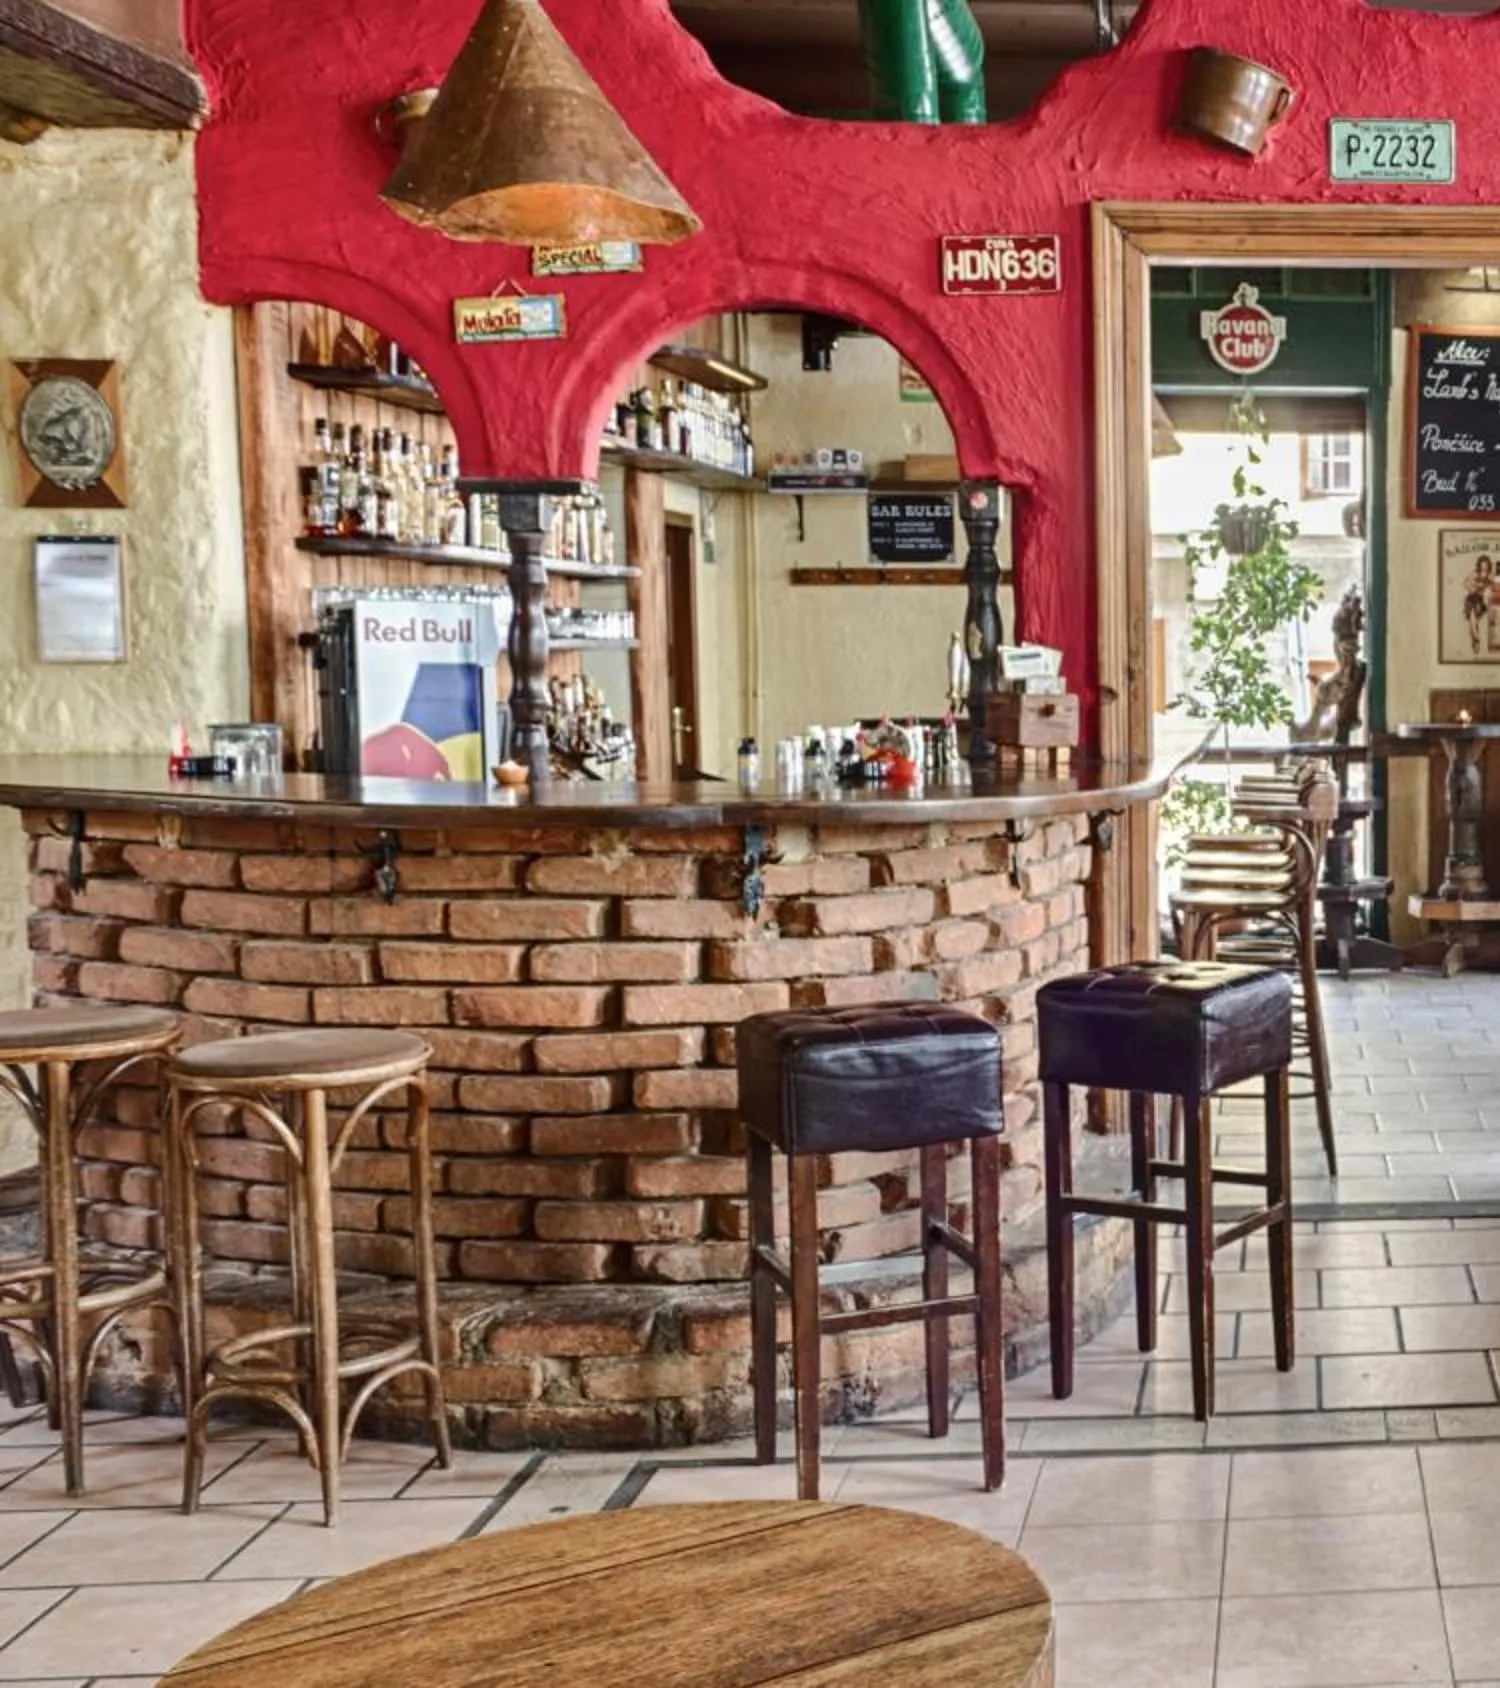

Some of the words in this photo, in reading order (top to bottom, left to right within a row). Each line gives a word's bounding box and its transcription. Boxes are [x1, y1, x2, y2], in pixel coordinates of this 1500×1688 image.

[945, 248, 1056, 280] HDN636
[1221, 337, 1266, 358] Club
[871, 504, 901, 517] BAR
[905, 504, 952, 517] RULES
[363, 616, 417, 642] Red
[421, 618, 473, 643] Bull
